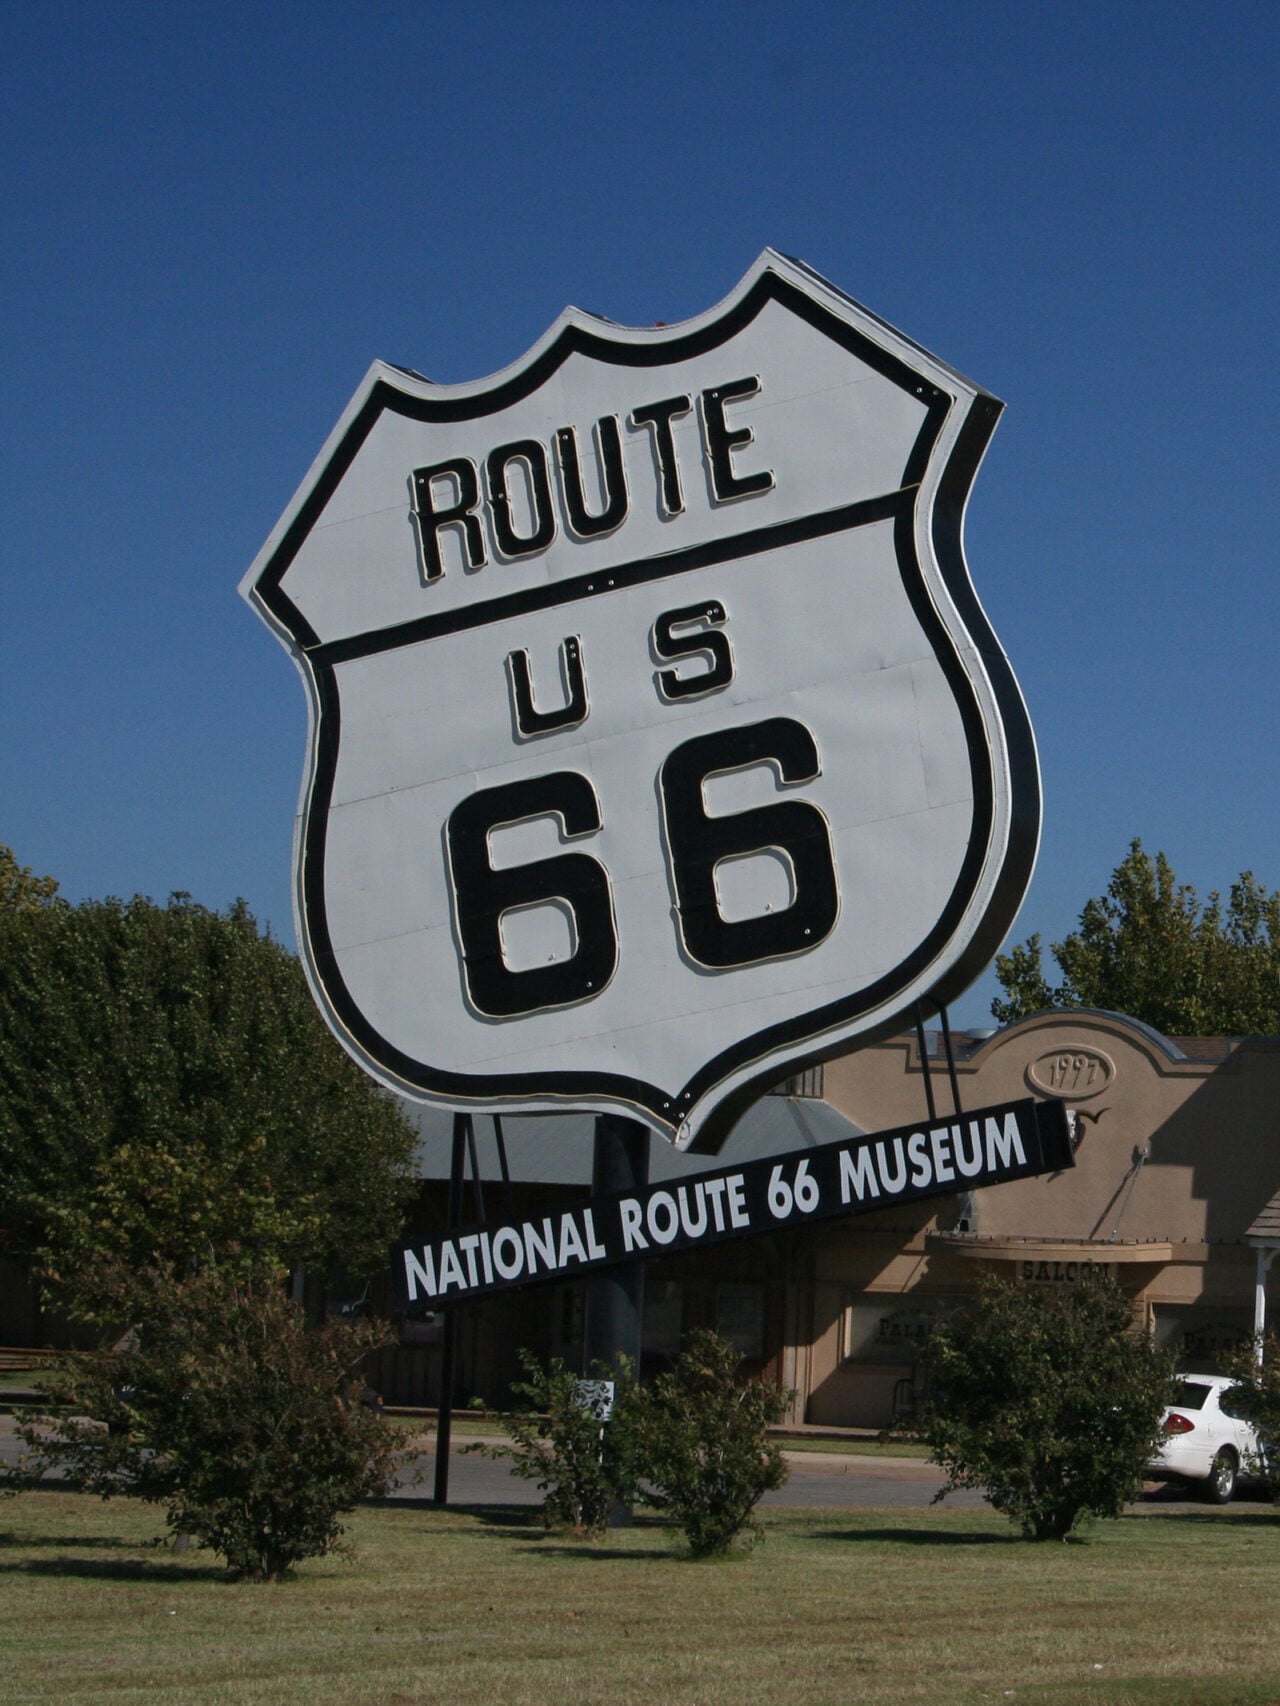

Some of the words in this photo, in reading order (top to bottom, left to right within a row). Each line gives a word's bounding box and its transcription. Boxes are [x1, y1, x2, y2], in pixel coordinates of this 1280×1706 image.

[411, 375, 775, 584] ROUTE
[446, 717, 843, 1019] 66
[1049, 1053, 1100, 1089] 1997
[403, 1208, 606, 1300] NATIONAL
[618, 1174, 751, 1252] ROUTE
[767, 1159, 820, 1220] 66
[839, 1112, 1028, 1204] MUSEUM
